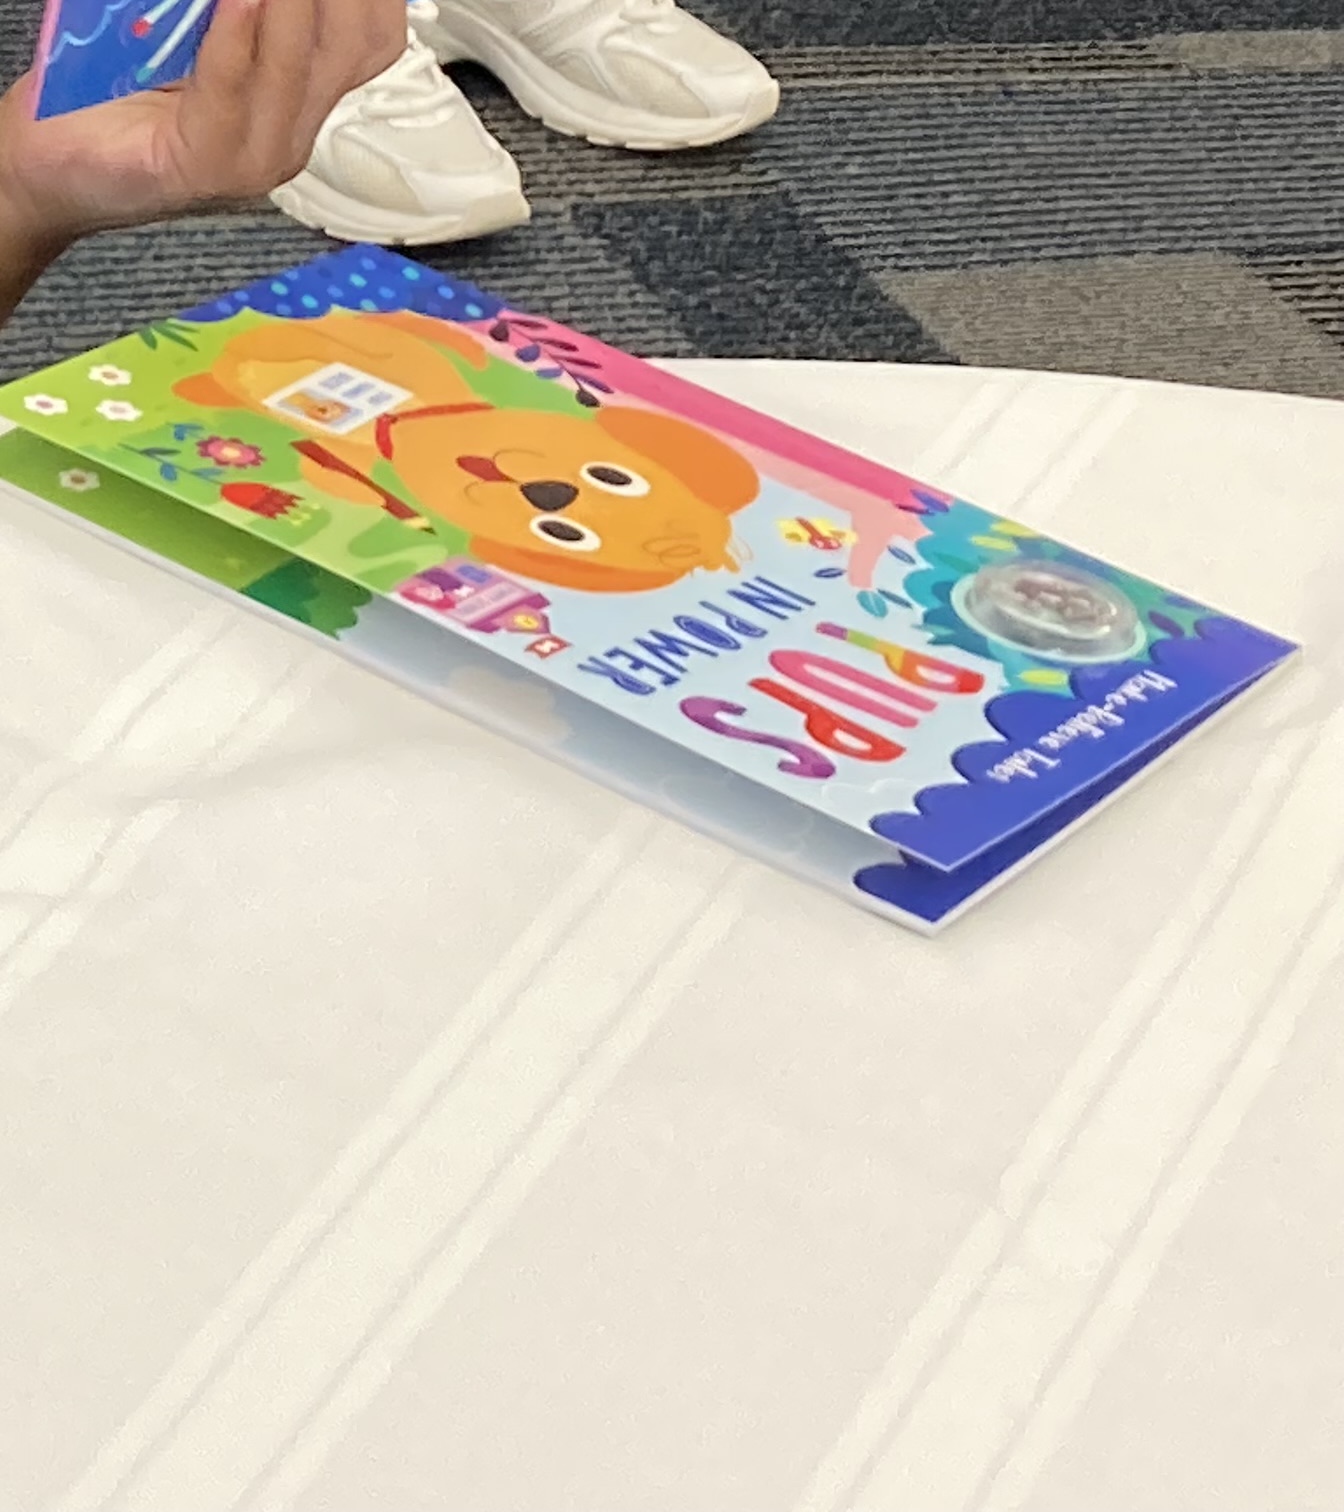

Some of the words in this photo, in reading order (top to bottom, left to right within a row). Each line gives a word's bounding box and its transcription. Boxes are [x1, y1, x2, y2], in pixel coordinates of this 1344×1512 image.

[728, 576, 816, 620] IN
[577, 600, 768, 696] POWER
[679, 621, 985, 779] PUPS
